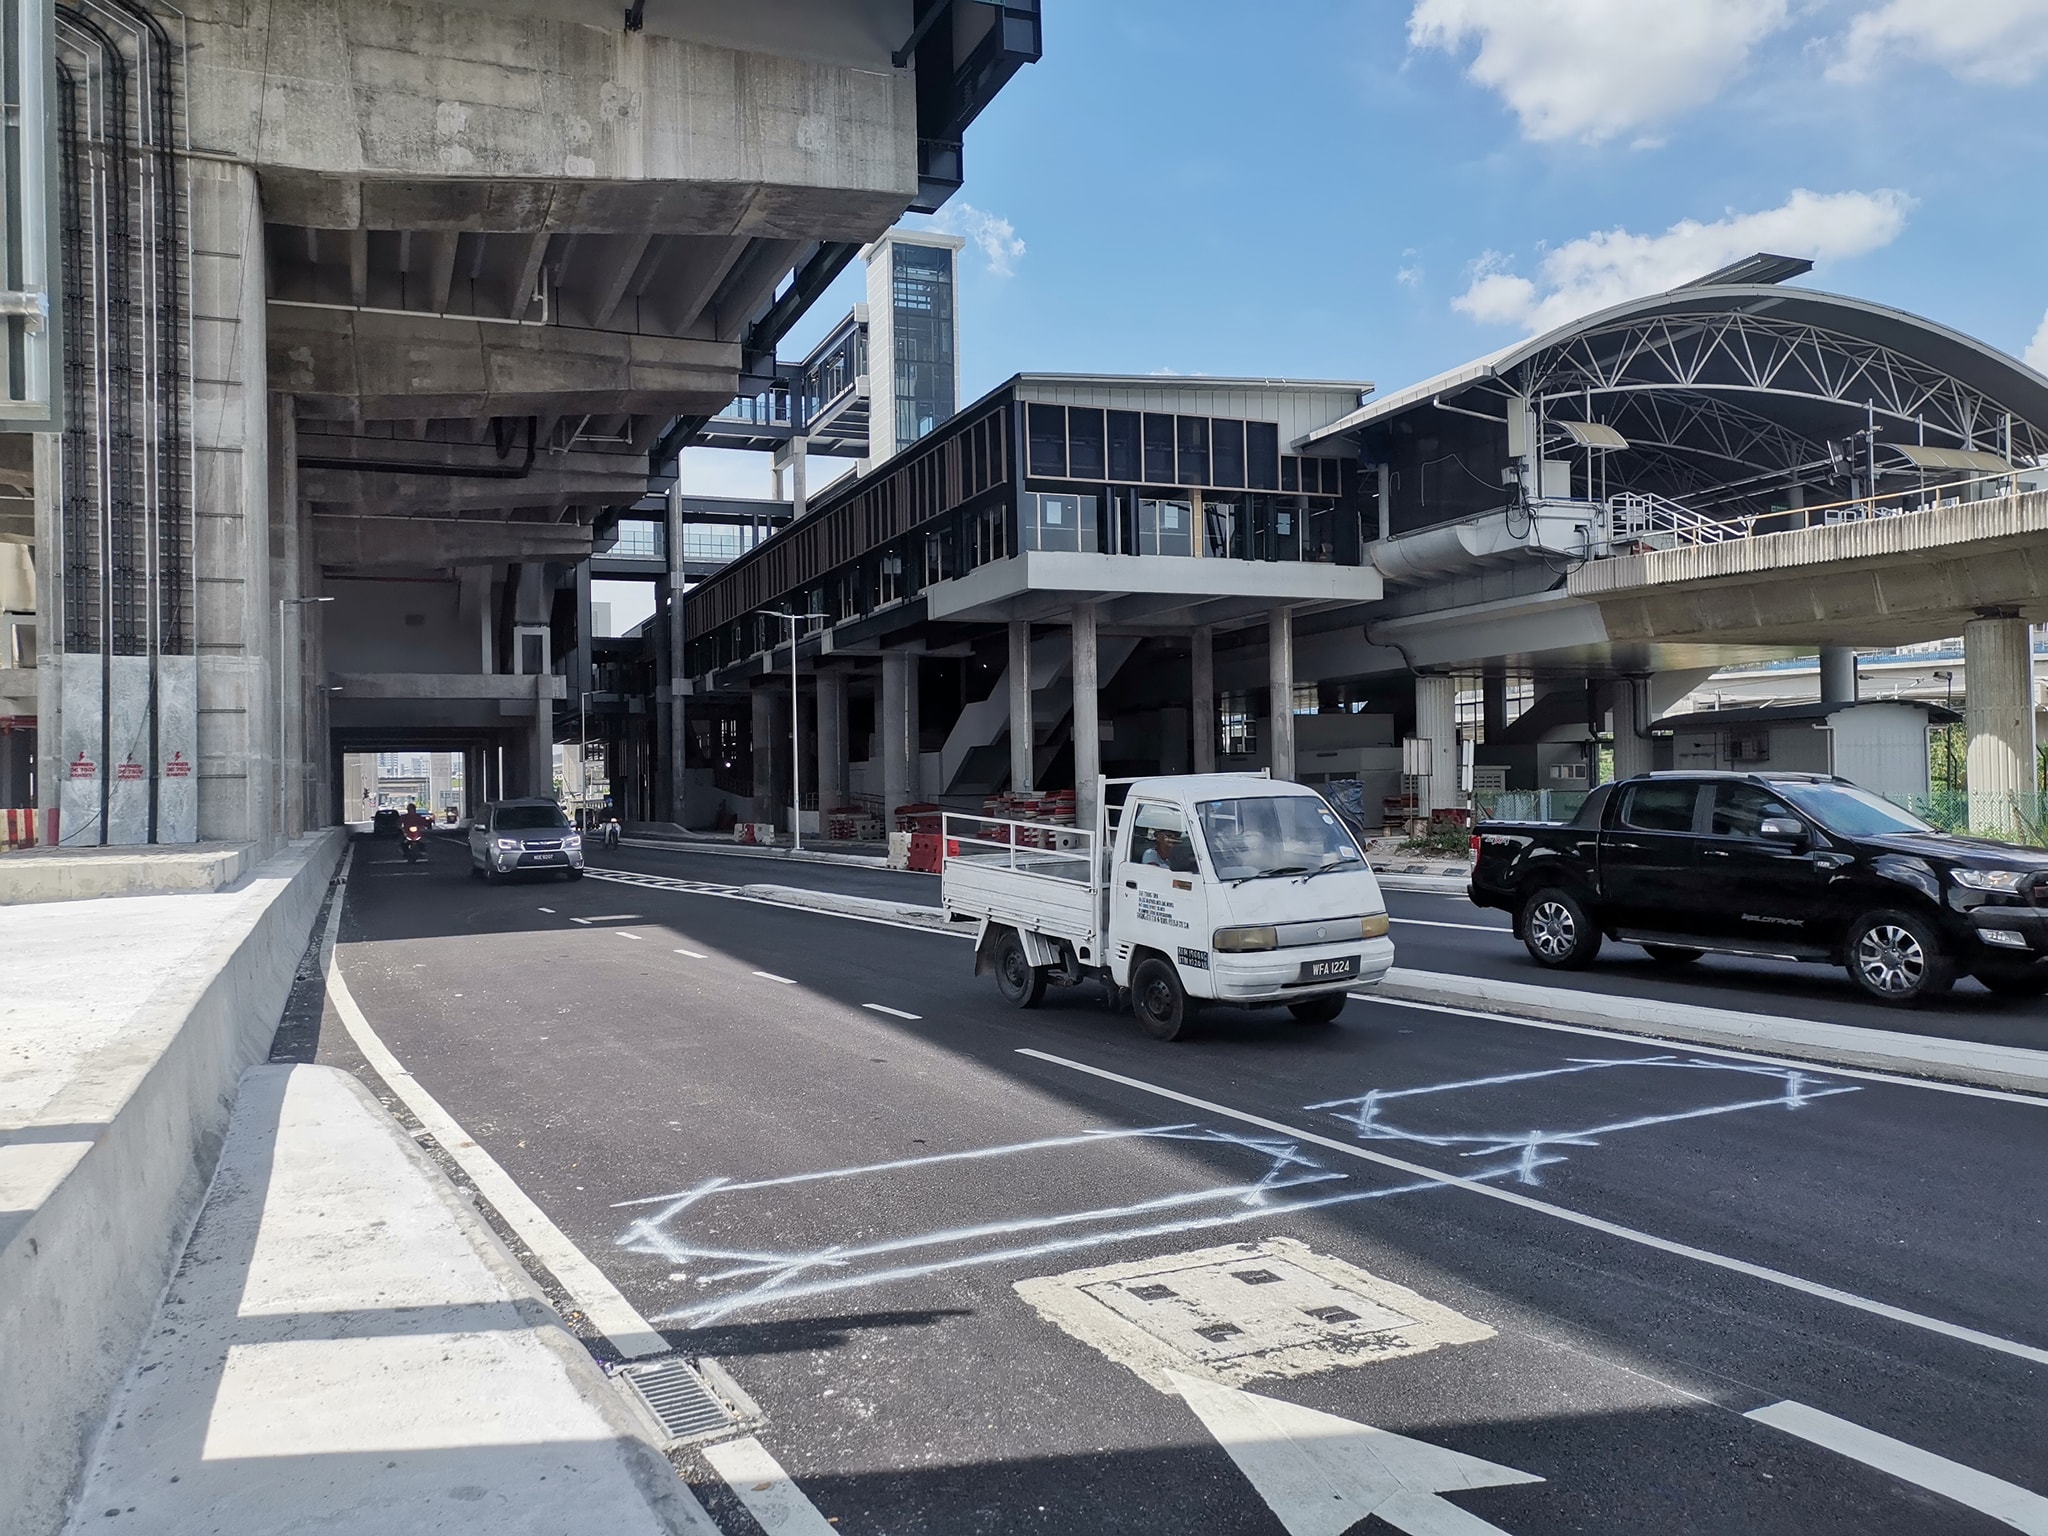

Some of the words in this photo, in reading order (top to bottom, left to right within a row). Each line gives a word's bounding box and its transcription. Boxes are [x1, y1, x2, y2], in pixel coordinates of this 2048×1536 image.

[1741, 913, 1805, 928] WILDTRAK
[1312, 963, 1329, 976] WFA
[1331, 960, 1350, 974] 1224
